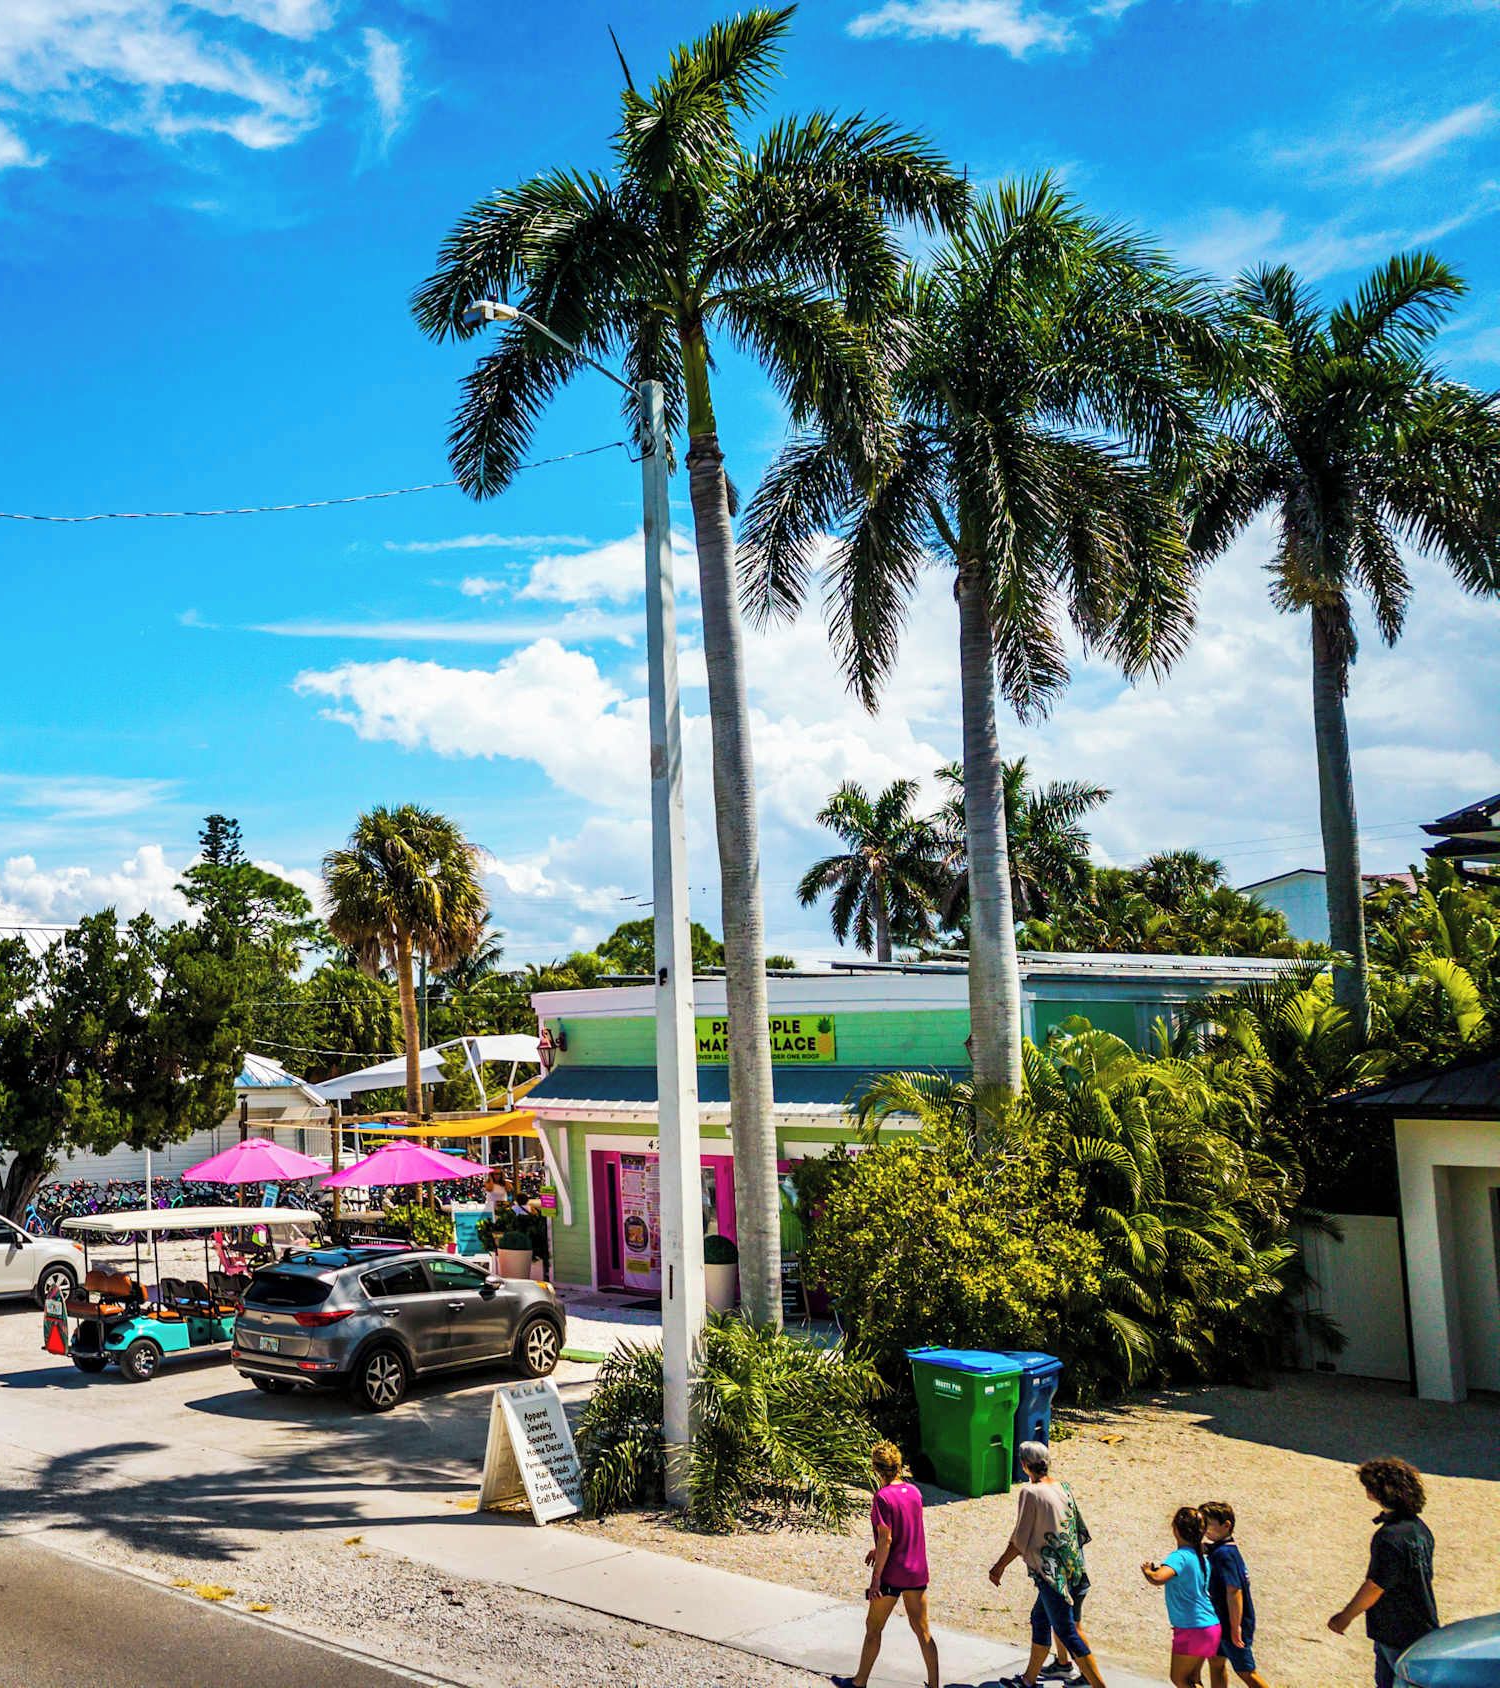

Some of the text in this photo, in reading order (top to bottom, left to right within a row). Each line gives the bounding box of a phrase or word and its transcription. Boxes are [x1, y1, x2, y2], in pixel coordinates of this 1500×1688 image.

[524, 1408, 548, 1422] Apparel
[527, 1421, 552, 1433] Jewelry
[527, 1432, 557, 1445] Souvenirs
[527, 1443, 564, 1457] Home Decor
[535, 1464, 570, 1480] Hair Braids
[535, 1481, 552, 1493] Food
[536, 1493, 551, 1505] Craft
